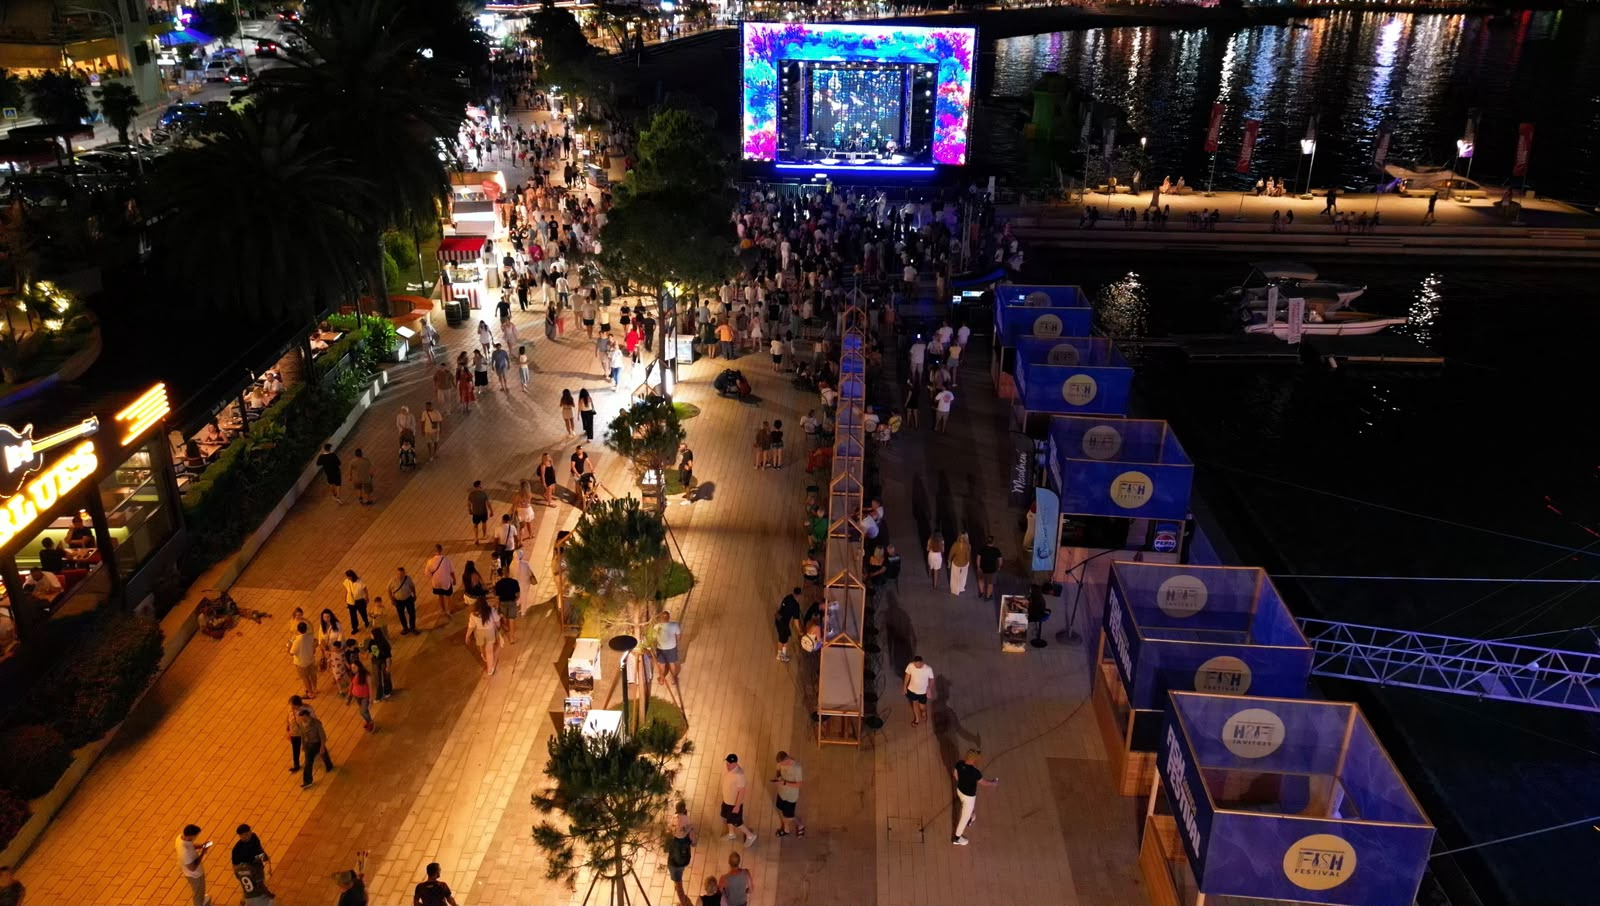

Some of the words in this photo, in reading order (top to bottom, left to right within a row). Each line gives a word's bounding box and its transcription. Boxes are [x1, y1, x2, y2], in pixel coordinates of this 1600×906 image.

[1119, 482, 1145, 495] FISH
[1207, 670, 1241, 686] FISH
[1166, 753, 1201, 859] FESTIVAL
[1298, 852, 1345, 870] FISH
[1294, 868, 1341, 878] FESTIVAL
[241, 876, 254, 893] 9
